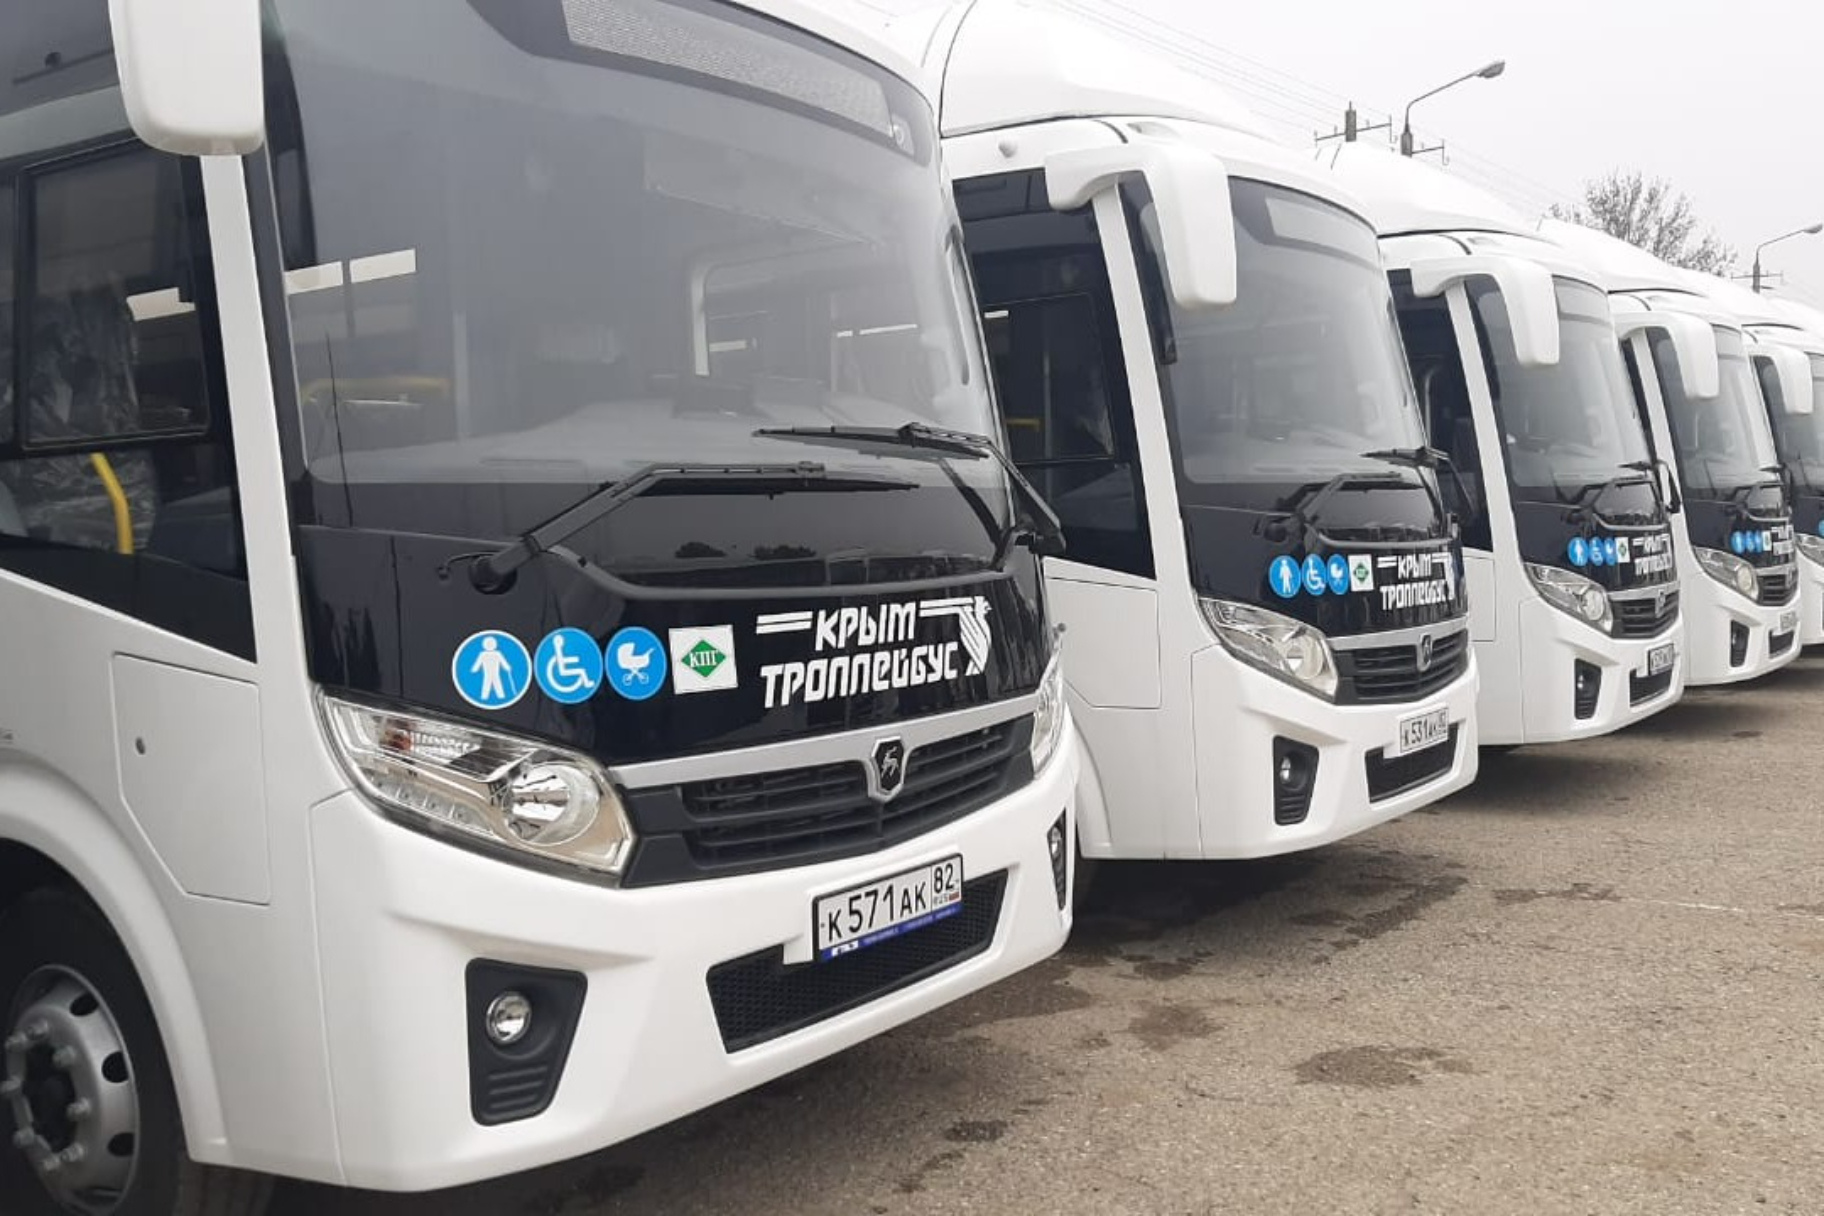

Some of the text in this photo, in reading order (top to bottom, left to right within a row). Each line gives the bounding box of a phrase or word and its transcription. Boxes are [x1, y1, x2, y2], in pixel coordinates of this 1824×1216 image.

[1397, 554, 1431, 579] КРЫМ
[815, 601, 917, 651] КРЫМ
[690, 650, 719, 668] КПГ
[760, 641, 958, 709] ТРОЛЛЕЙБУС
[933, 862, 954, 894] 82
